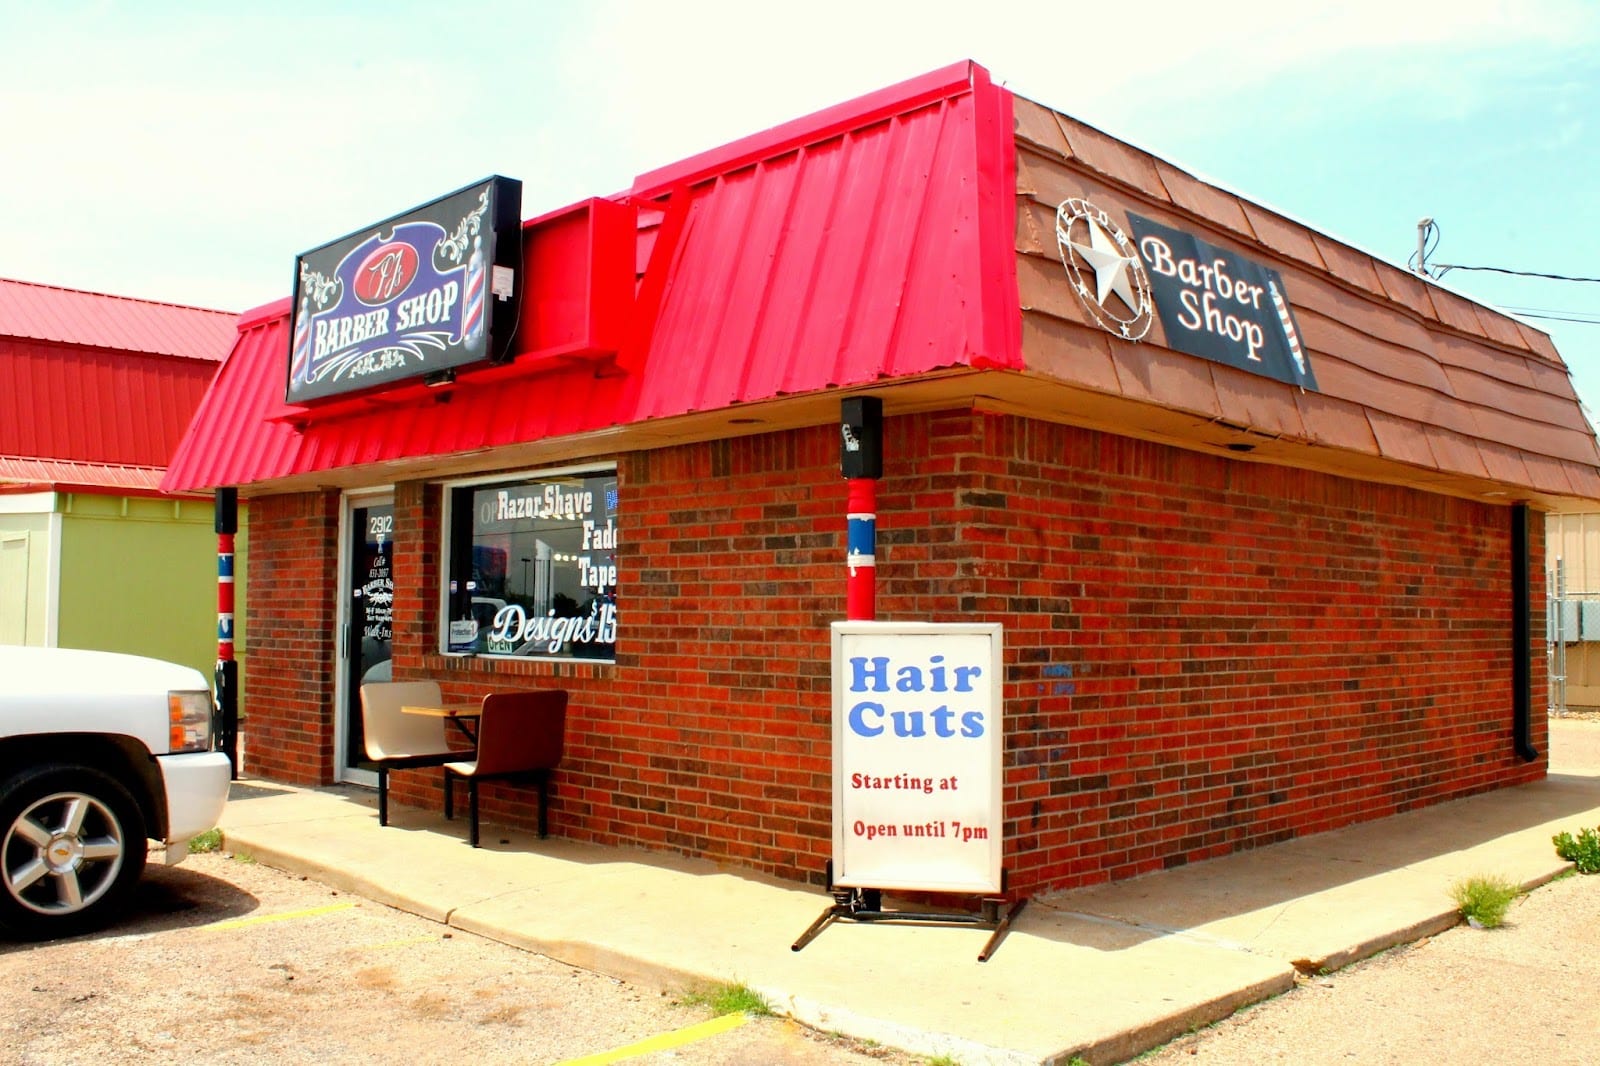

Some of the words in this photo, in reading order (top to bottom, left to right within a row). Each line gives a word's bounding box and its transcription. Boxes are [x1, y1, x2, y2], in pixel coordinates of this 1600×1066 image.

[1140, 235, 1264, 309] Barber
[313, 307, 389, 362] BARBER
[396, 280, 458, 331] SHOP
[1177, 290, 1264, 361] Shop
[497, 491, 543, 520] Razor
[544, 485, 593, 516] Shave
[370, 515, 393, 534] 2912
[491, 605, 594, 653] Designs
[849, 655, 982, 692] Hair
[848, 701, 985, 738] Cuts
[851, 773, 933, 794] Starting
[939, 775, 958, 790] at
[853, 820, 897, 841] Open
[903, 822, 945, 838] until
[951, 822, 988, 842] 7pm
